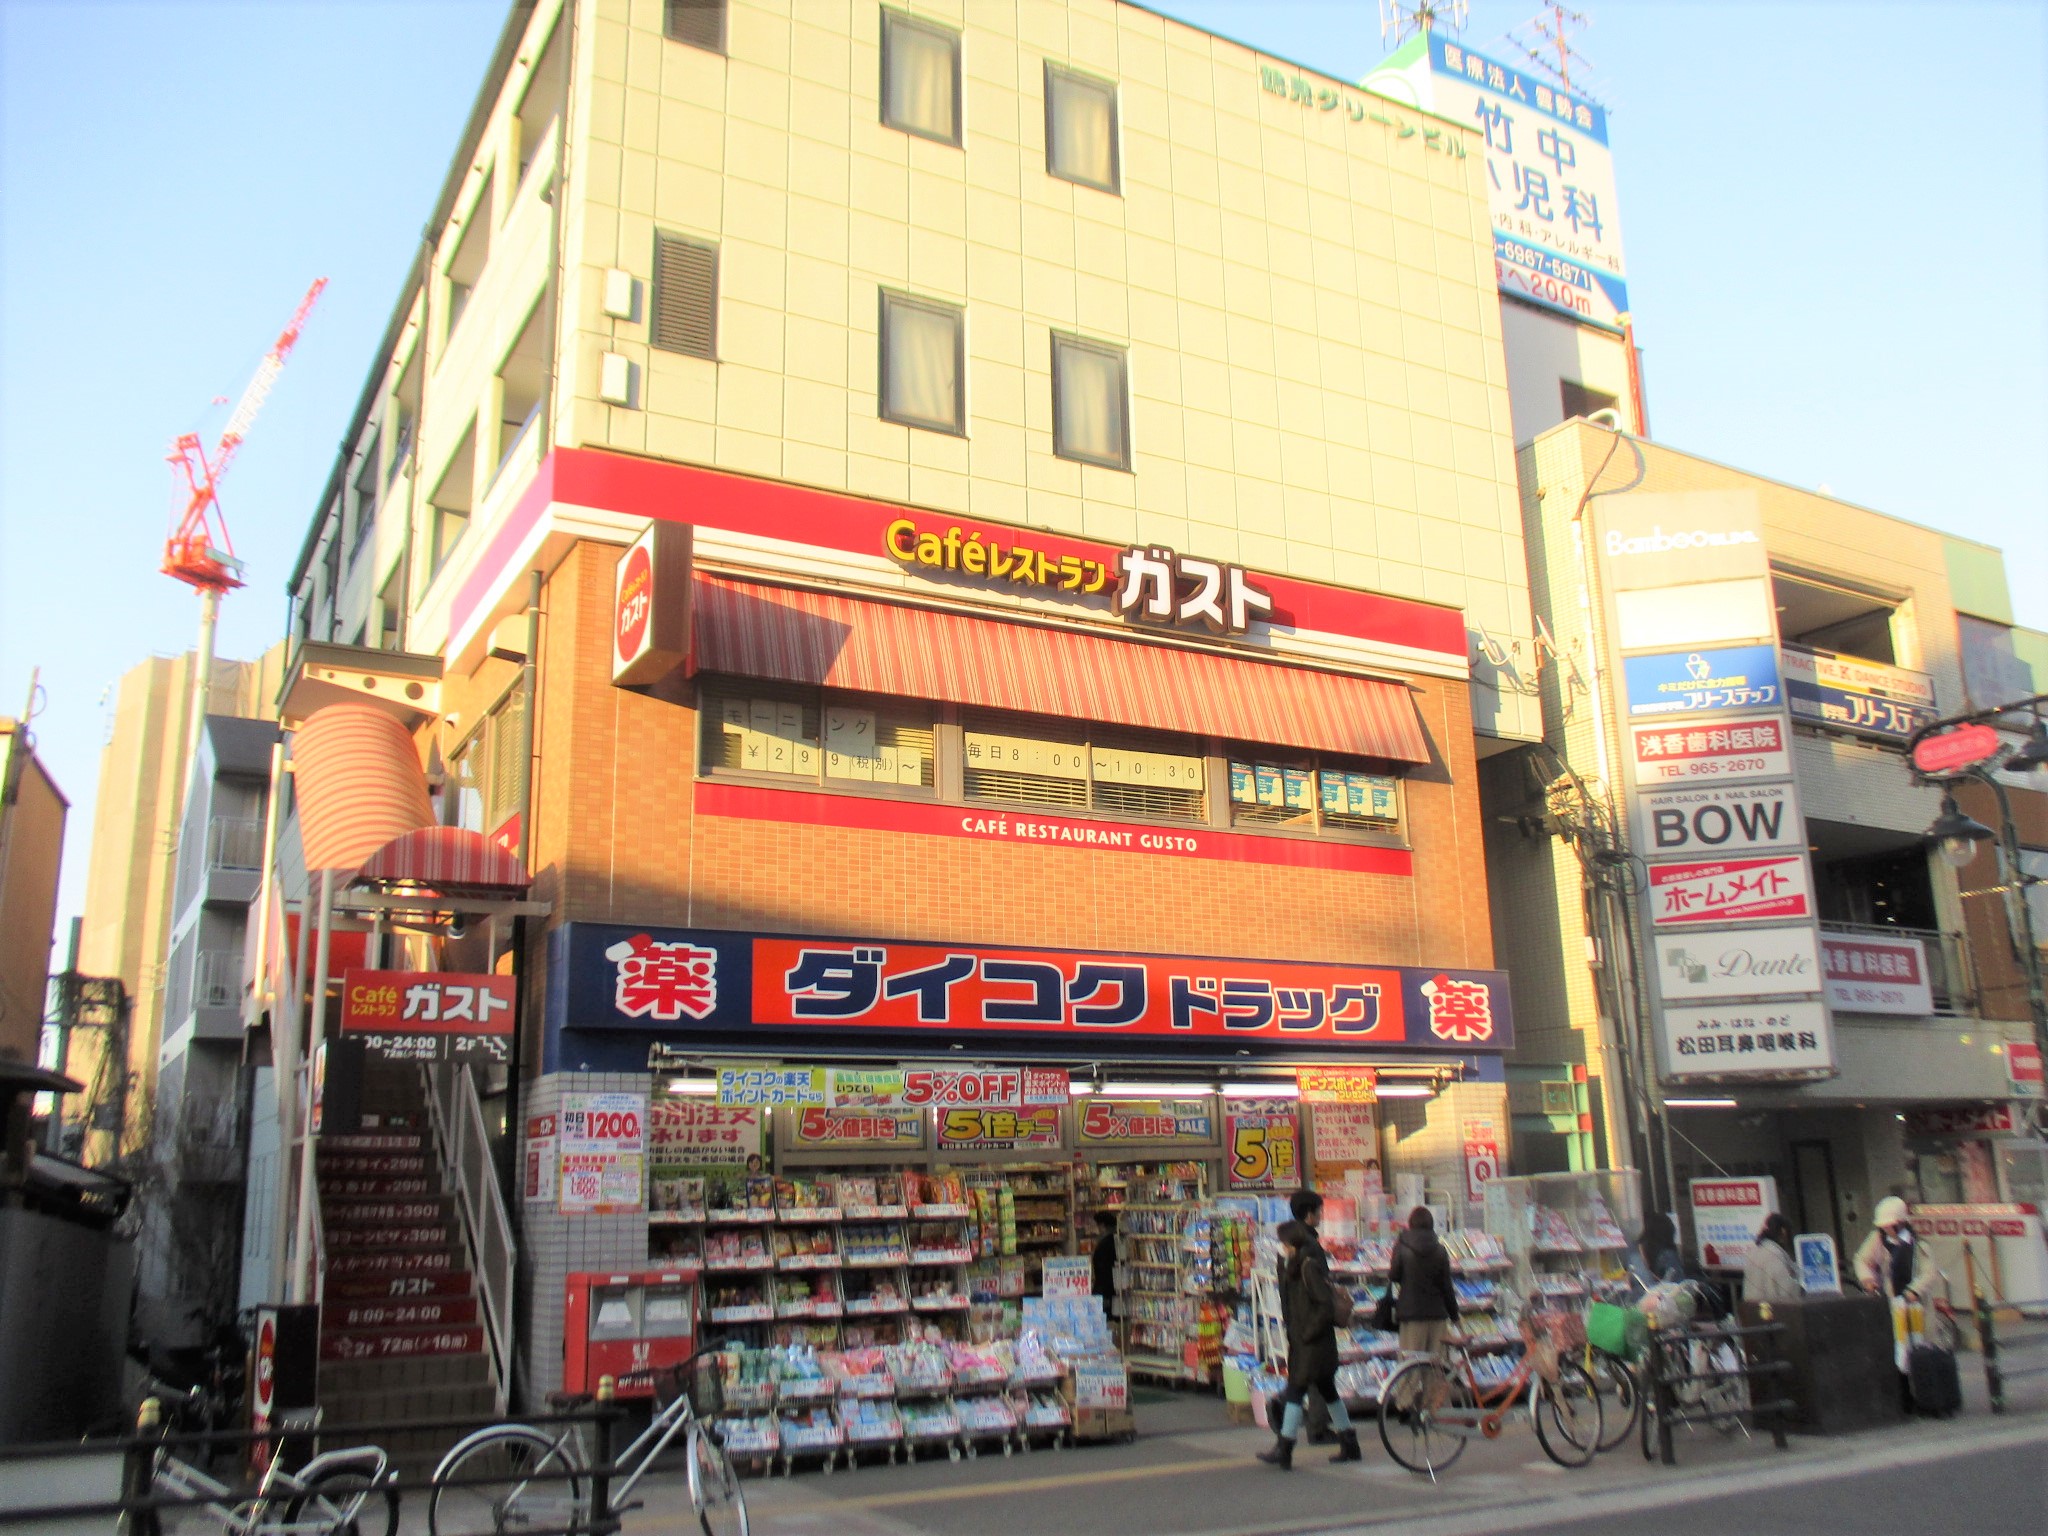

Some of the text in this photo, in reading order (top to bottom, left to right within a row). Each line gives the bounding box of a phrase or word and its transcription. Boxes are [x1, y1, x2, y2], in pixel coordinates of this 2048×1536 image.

[1474, 95, 1577, 176] 竹中
[1120, 546, 1273, 631] ガスト
[620, 590, 649, 636] ガスト
[1683, 685, 1777, 710] フリーステップ
[726, 707, 870, 737] モーニング
[1641, 726, 1778, 757] 浅香歯科医院
[1659, 757, 1766, 777] TEL 965-2670
[1650, 795, 1674, 806] HAIR
[1676, 792, 1710, 804] SALON
[1725, 790, 1749, 800] NAIL
[1750, 787, 1784, 798] SALON
[961, 813, 1198, 853] CAFÉ RESTAURANT GUSTO
[1652, 800, 1784, 848] BOW
[1664, 868, 1790, 913] ホームメイト
[614, 935, 718, 1020] 薬
[1712, 948, 1814, 978] Dante
[351, 984, 398, 1004] Café
[402, 982, 509, 1022] ガスト
[784, 946, 1381, 1036] ダイコク ドラッグ
[351, 1003, 397, 1017] レストラン
[1428, 976, 1495, 1042] 薬
[456, 1036, 477, 1051] 2F
[1676, 1030, 1819, 1057] 松田耳鼻咽喉科
[720, 1070, 811, 1088] ダイコクの楽天
[902, 1069, 1021, 1107] 5%OFF
[1299, 1076, 1374, 1091] ボーナスポイント
[718, 1087, 825, 1106] ポイントカードなら
[941, 1107, 1054, 1141] 5倍デー
[1083, 1103, 1176, 1139] 5%値引き
[1178, 1119, 1206, 1133] SALE
[389, 1277, 435, 1296] ガスト
